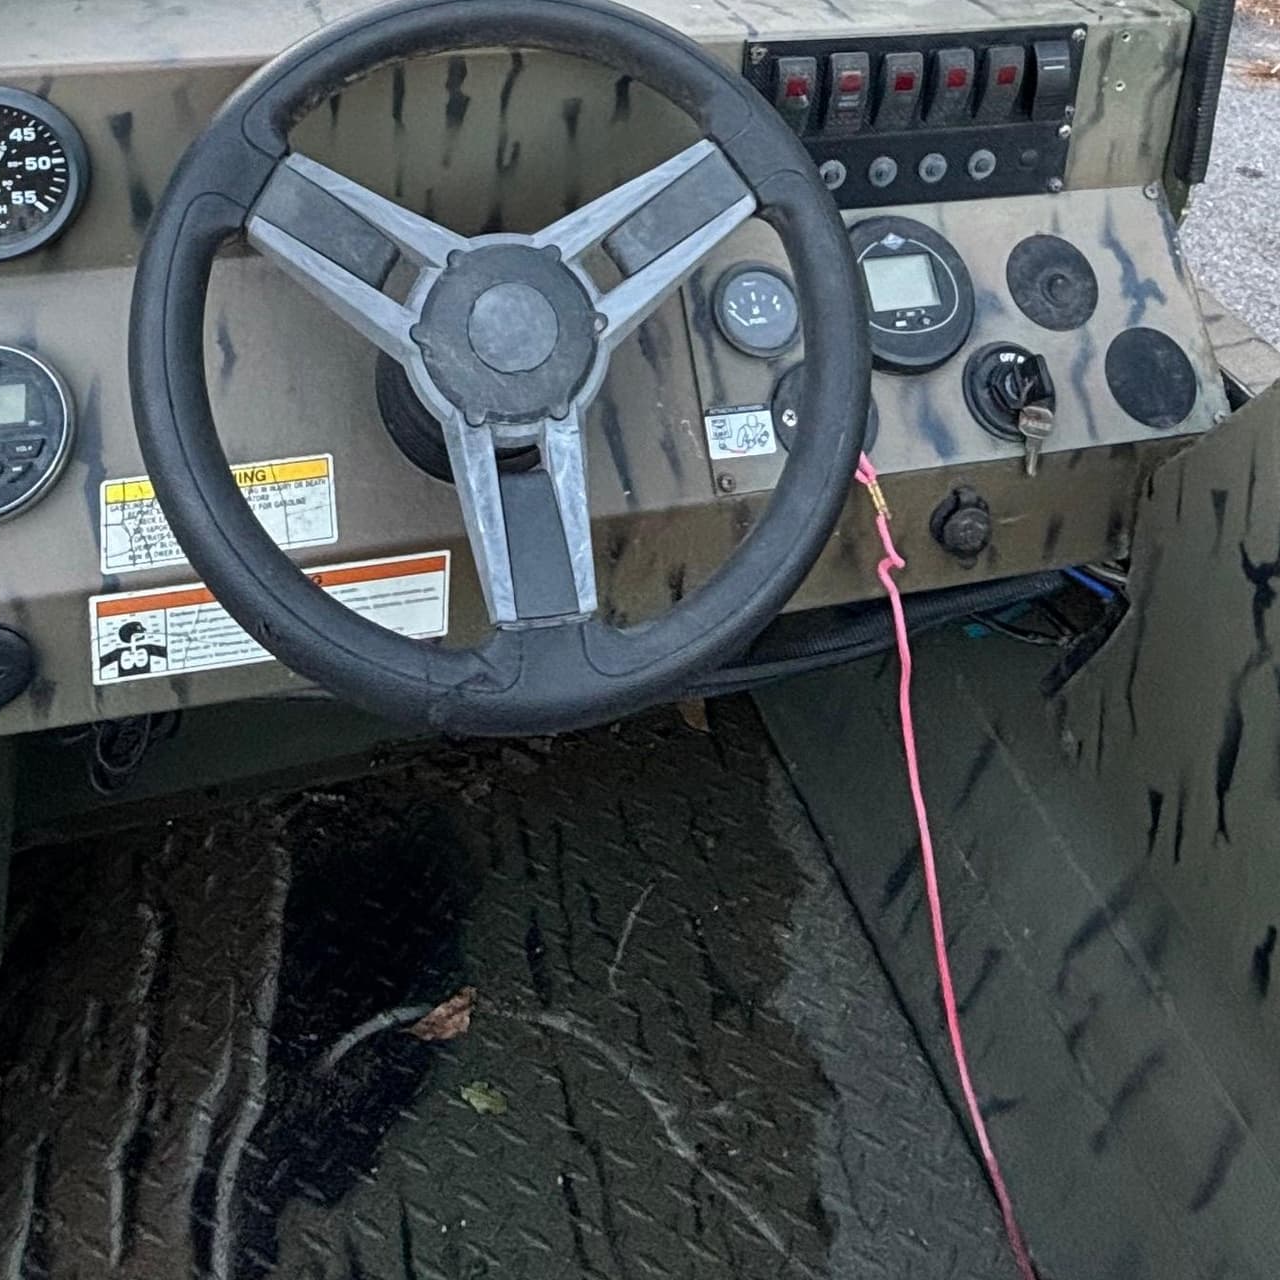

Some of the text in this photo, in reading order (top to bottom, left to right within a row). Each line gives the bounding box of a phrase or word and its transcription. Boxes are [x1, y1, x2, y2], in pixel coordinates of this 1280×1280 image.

[9, 127, 36, 142] 45
[25, 156, 51, 171] 50
[11, 190, 37, 205] 55
[999, 352, 1016, 362] OFF
